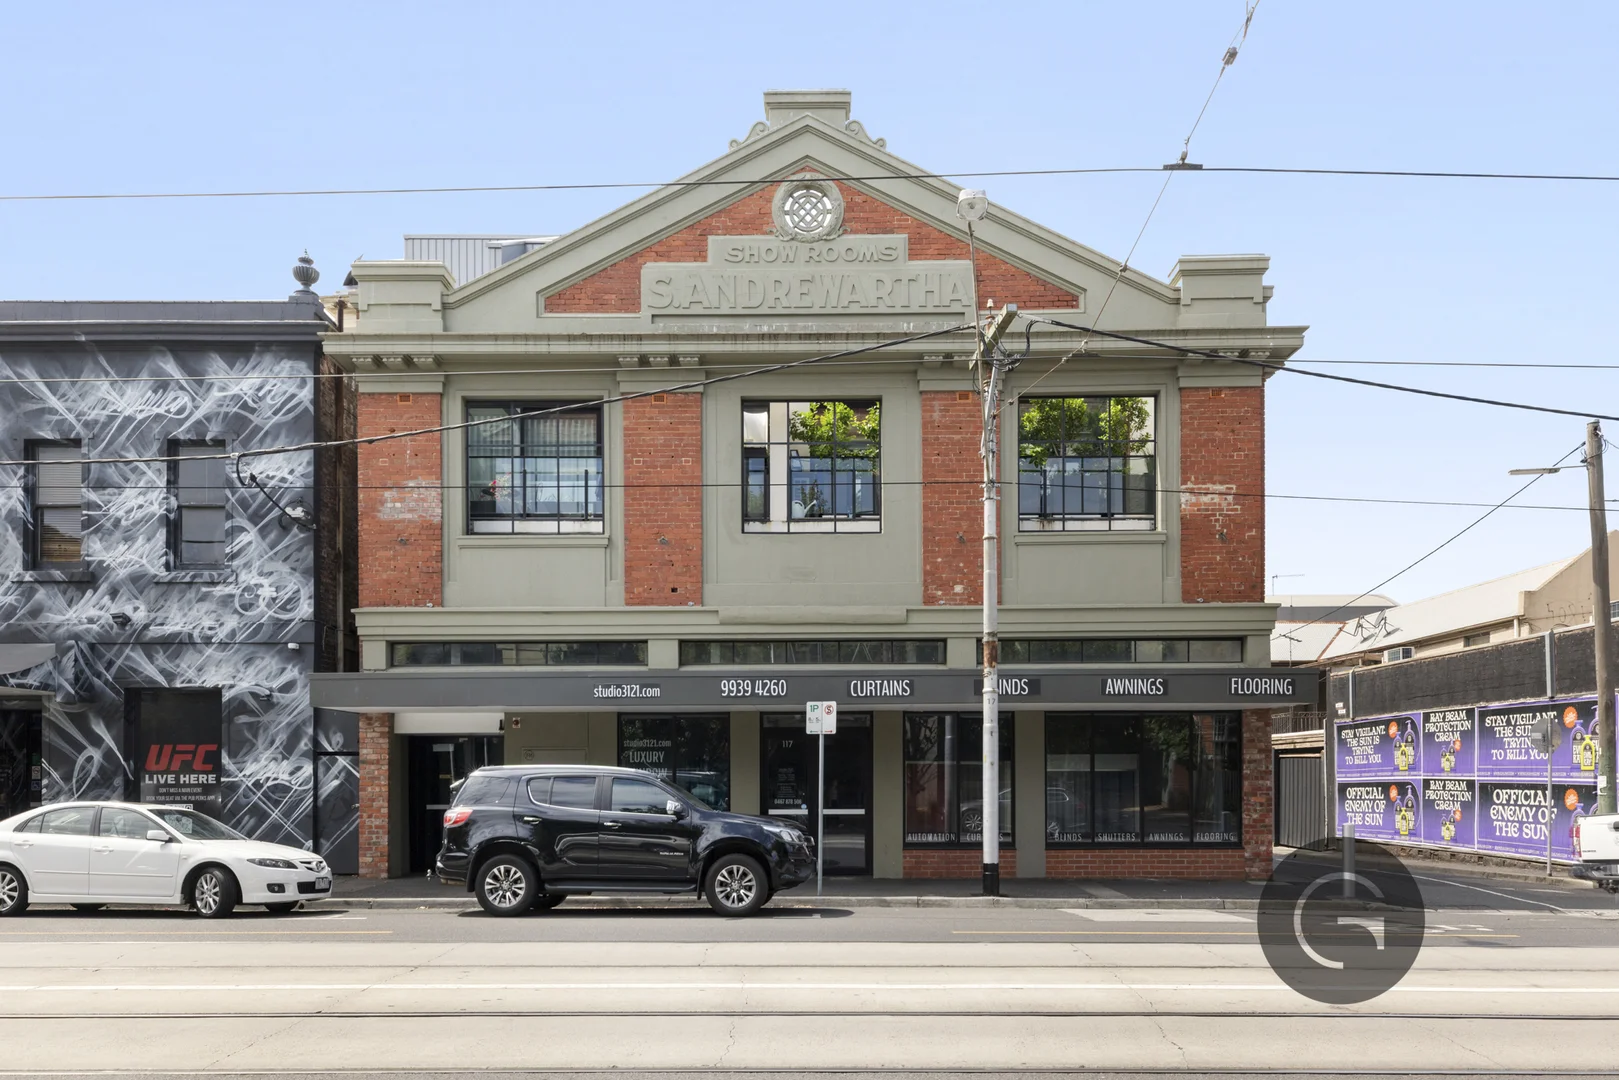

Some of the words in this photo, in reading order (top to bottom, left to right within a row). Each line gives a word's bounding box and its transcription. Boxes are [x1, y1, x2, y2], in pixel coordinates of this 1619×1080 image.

[725, 246, 798, 264] SHOW
[805, 246, 898, 263] ROOMS
[593, 684, 661, 698] studio3121.com
[720, 680, 752, 697] 9939
[754, 679, 787, 696] 4260
[850, 680, 911, 697] CURTAINS
[999, 679, 1029, 695] INDS
[1105, 679, 1164, 695] AWNINGS
[1231, 678, 1292, 695] FLOORING
[809, 704, 819, 712] 1P
[1430, 712, 1444, 722] RAY
[1445, 710, 1467, 721] BEAM
[1485, 715, 1508, 727] STAY
[1425, 720, 1471, 732] PROTECTION
[1494, 726, 1514, 738] THE
[1341, 729, 1354, 739] STAY
[1435, 731, 1460, 742] CREAM
[623, 739, 671, 747] studio3121.com
[782, 740, 793, 748] 117
[1347, 738, 1359, 747] THE
[1359, 737, 1372, 746] SUN
[1373, 736, 1380, 745] IS
[1503, 737, 1535, 749] TRYIN
[629, 751, 665, 763] LUXURY
[1352, 746, 1374, 756] TRYING
[1491, 749, 1504, 760] TO
[1506, 749, 1528, 760] KILL
[144, 744, 218, 771] UFC
[1345, 756, 1354, 765] TO
[1354, 755, 1368, 764] KILL
[145, 774, 176, 784] LIVE
[180, 774, 217, 784] HERE
[1430, 780, 1444, 790] RAY
[1445, 780, 1467, 790] BEAM
[1346, 787, 1384, 799] OFFICIAL
[1425, 790, 1472, 801] PROTECTION
[1345, 800, 1373, 812] ENEMY
[1374, 800, 1386, 813] OF
[1435, 801, 1461, 811] CREAM
[1347, 812, 1363, 825] THE
[1364, 813, 1383, 826] SUN
[1490, 805, 1536, 822] ENEMY
[1493, 821, 1520, 837] THE
[907, 833, 955, 841] AUTOMATION
[1055, 833, 1082, 841] BLINDS
[1097, 833, 1136, 841] SHUTTERS
[1149, 833, 1184, 841] AWNINGS
[1196, 832, 1234, 841] FLOORING
